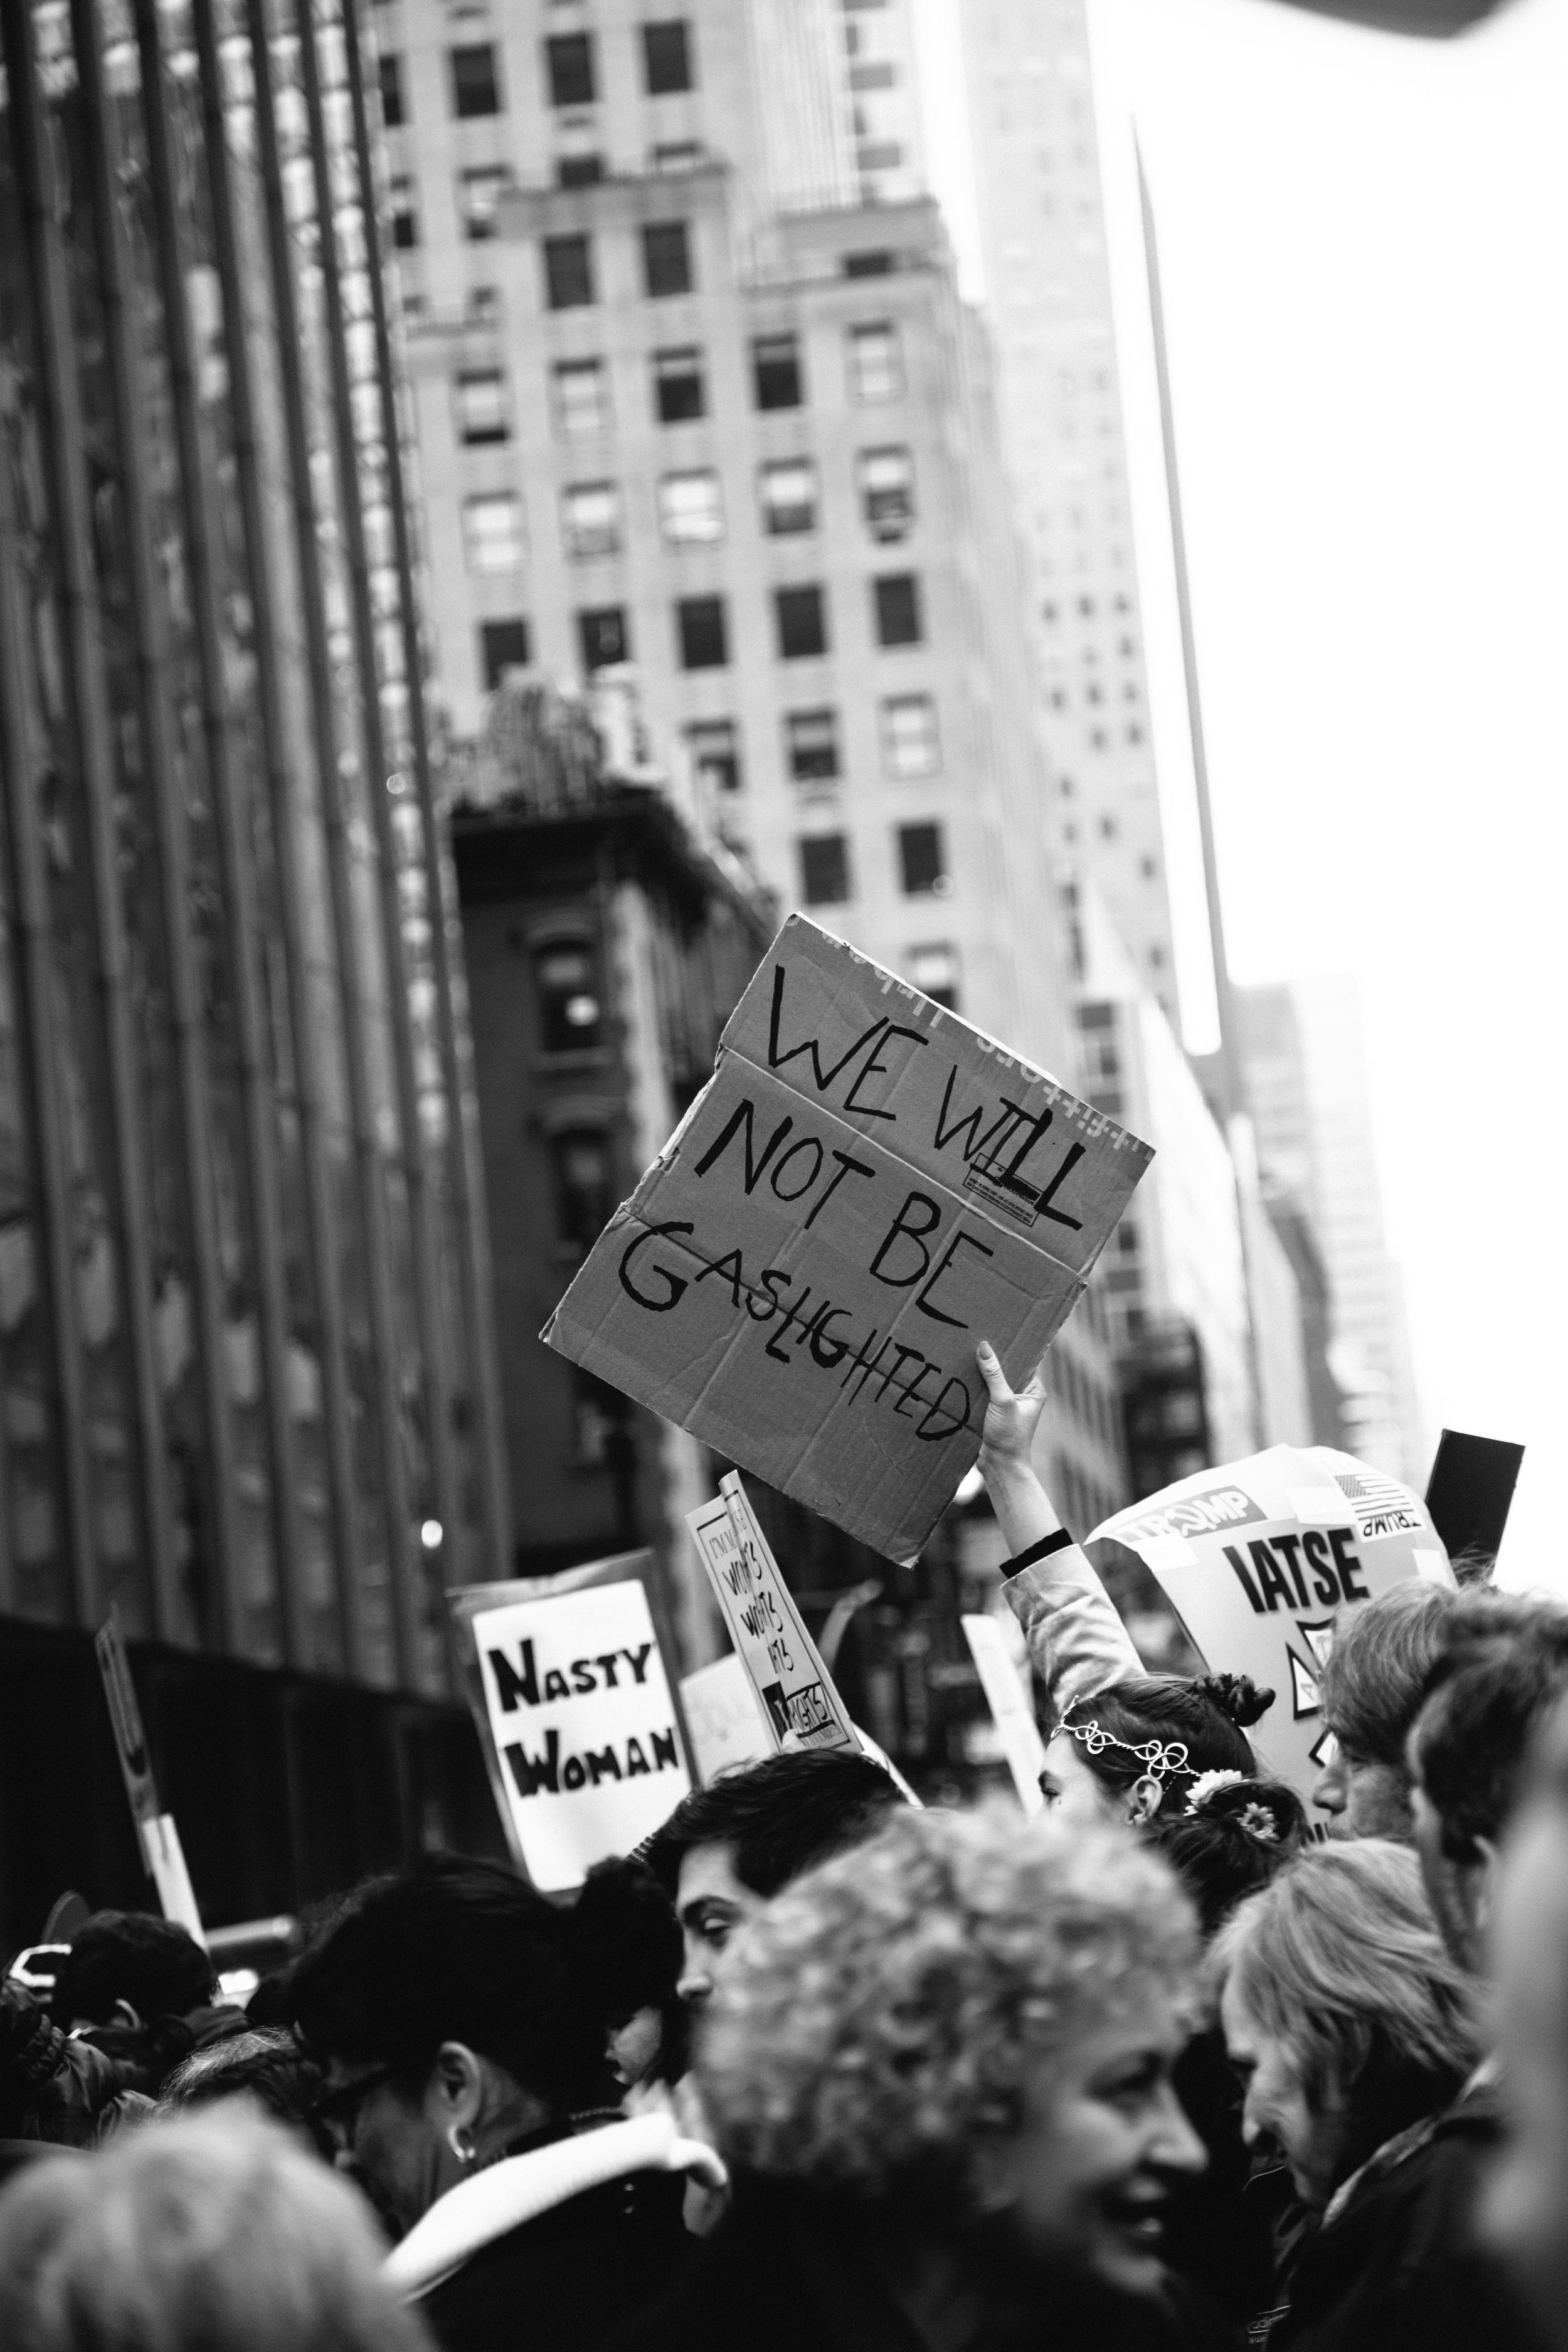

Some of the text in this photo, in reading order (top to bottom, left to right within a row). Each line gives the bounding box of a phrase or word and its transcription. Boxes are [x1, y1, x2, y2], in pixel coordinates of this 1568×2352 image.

[768, 964, 929, 1120] WE
[934, 1064, 1086, 1231] WILL
[694, 1099, 994, 1329] NOT BE
[618, 1222, 971, 1442] GASLIGHTED
[1222, 1528, 1371, 1614] IATSE
[488, 1638, 652, 1713] NASTY
[502, 1728, 679, 1798] WOMAN
